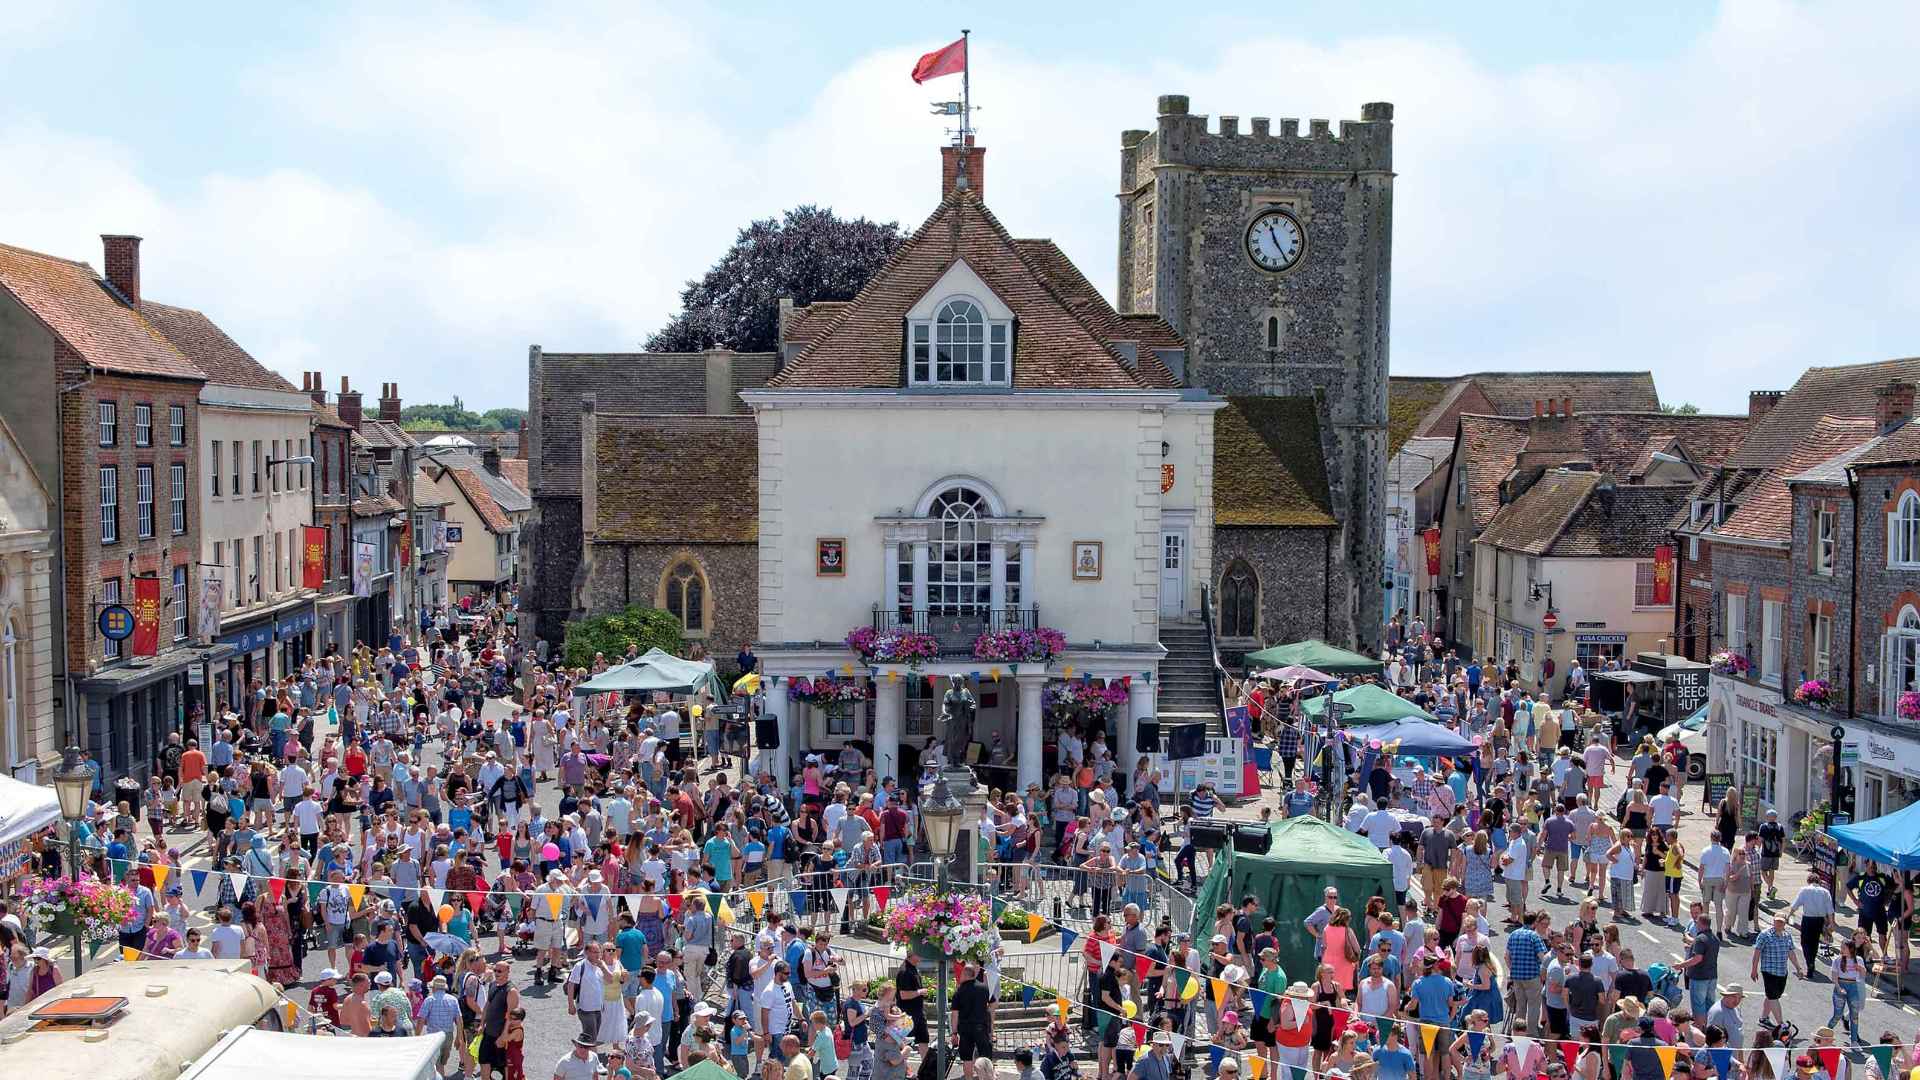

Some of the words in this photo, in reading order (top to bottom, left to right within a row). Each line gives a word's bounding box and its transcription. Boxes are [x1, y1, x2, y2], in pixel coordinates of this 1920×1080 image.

[1676, 673, 1698, 685] THE
[1678, 686, 1709, 698] BEEC
[1834, 728, 1842, 737] A
[1205, 739, 1221, 754] OU
